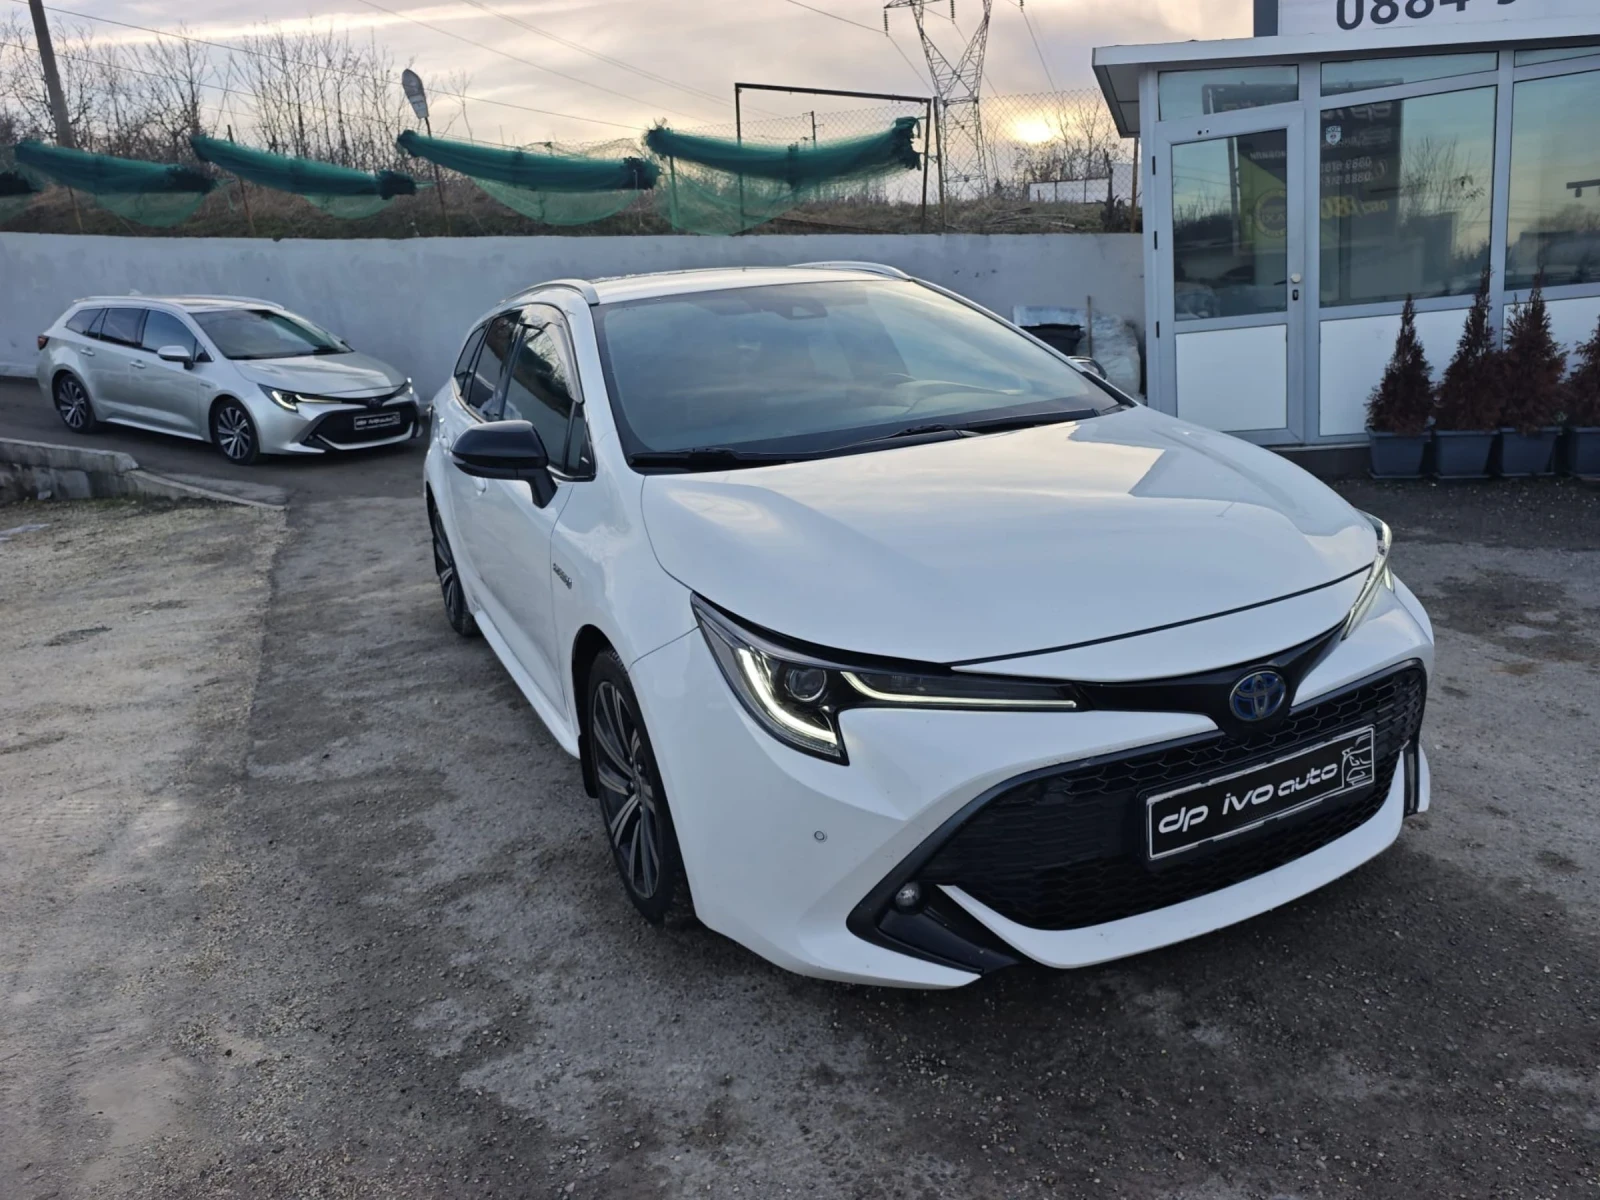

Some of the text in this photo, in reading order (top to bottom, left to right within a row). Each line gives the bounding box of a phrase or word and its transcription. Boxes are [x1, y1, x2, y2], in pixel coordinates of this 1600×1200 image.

[1336, 0, 1470, 30] 08
[1158, 763, 1338, 834] dp ivo auto
